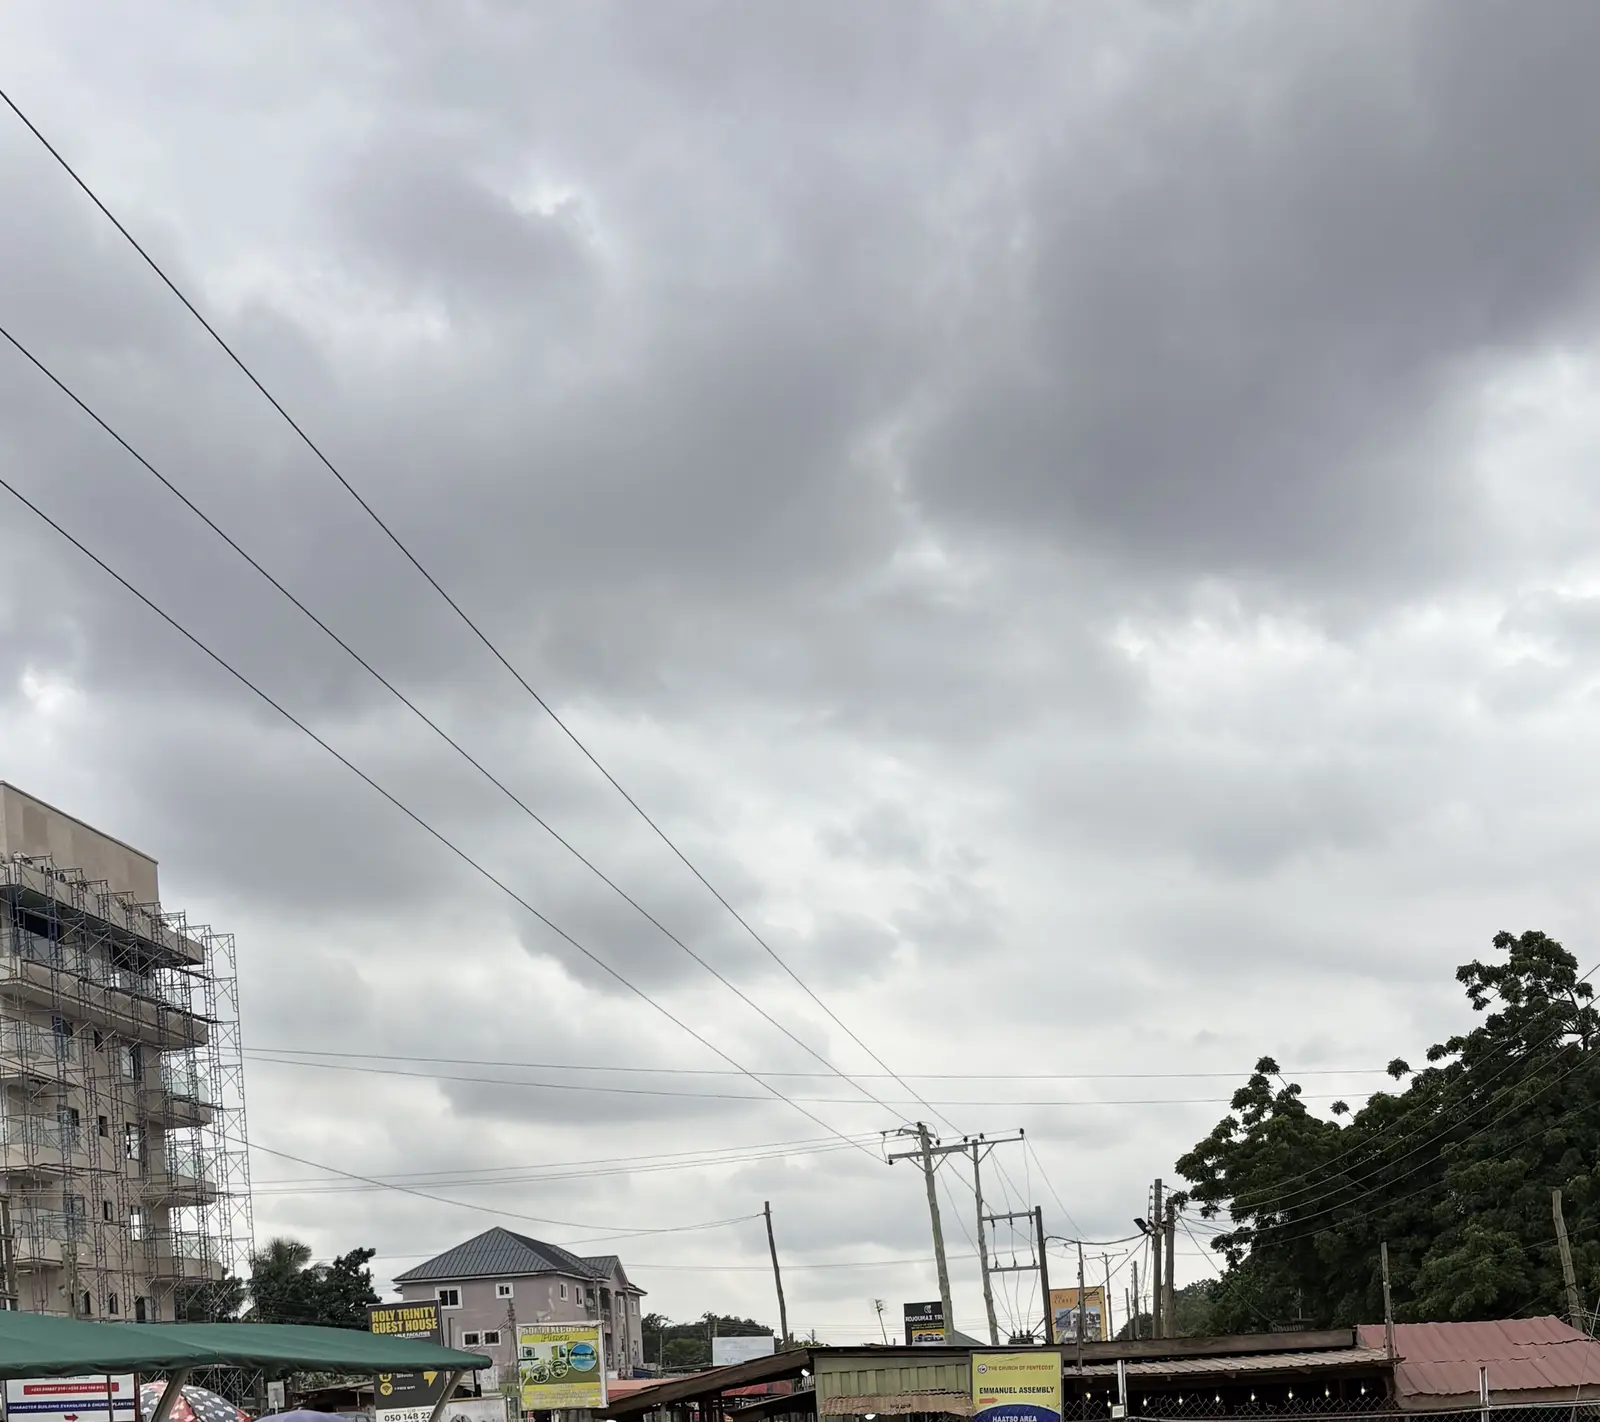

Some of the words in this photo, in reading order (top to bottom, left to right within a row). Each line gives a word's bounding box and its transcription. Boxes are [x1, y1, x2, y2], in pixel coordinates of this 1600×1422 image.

[371, 1310, 395, 1322] HOLY
[397, 1306, 436, 1320] TRINITY
[372, 1321, 404, 1334] GUEST
[405, 1318, 438, 1331] HOUSE
[979, 1386, 1017, 1394] EMMANUEL
[1018, 1386, 1055, 1394] ASSEMBLY
